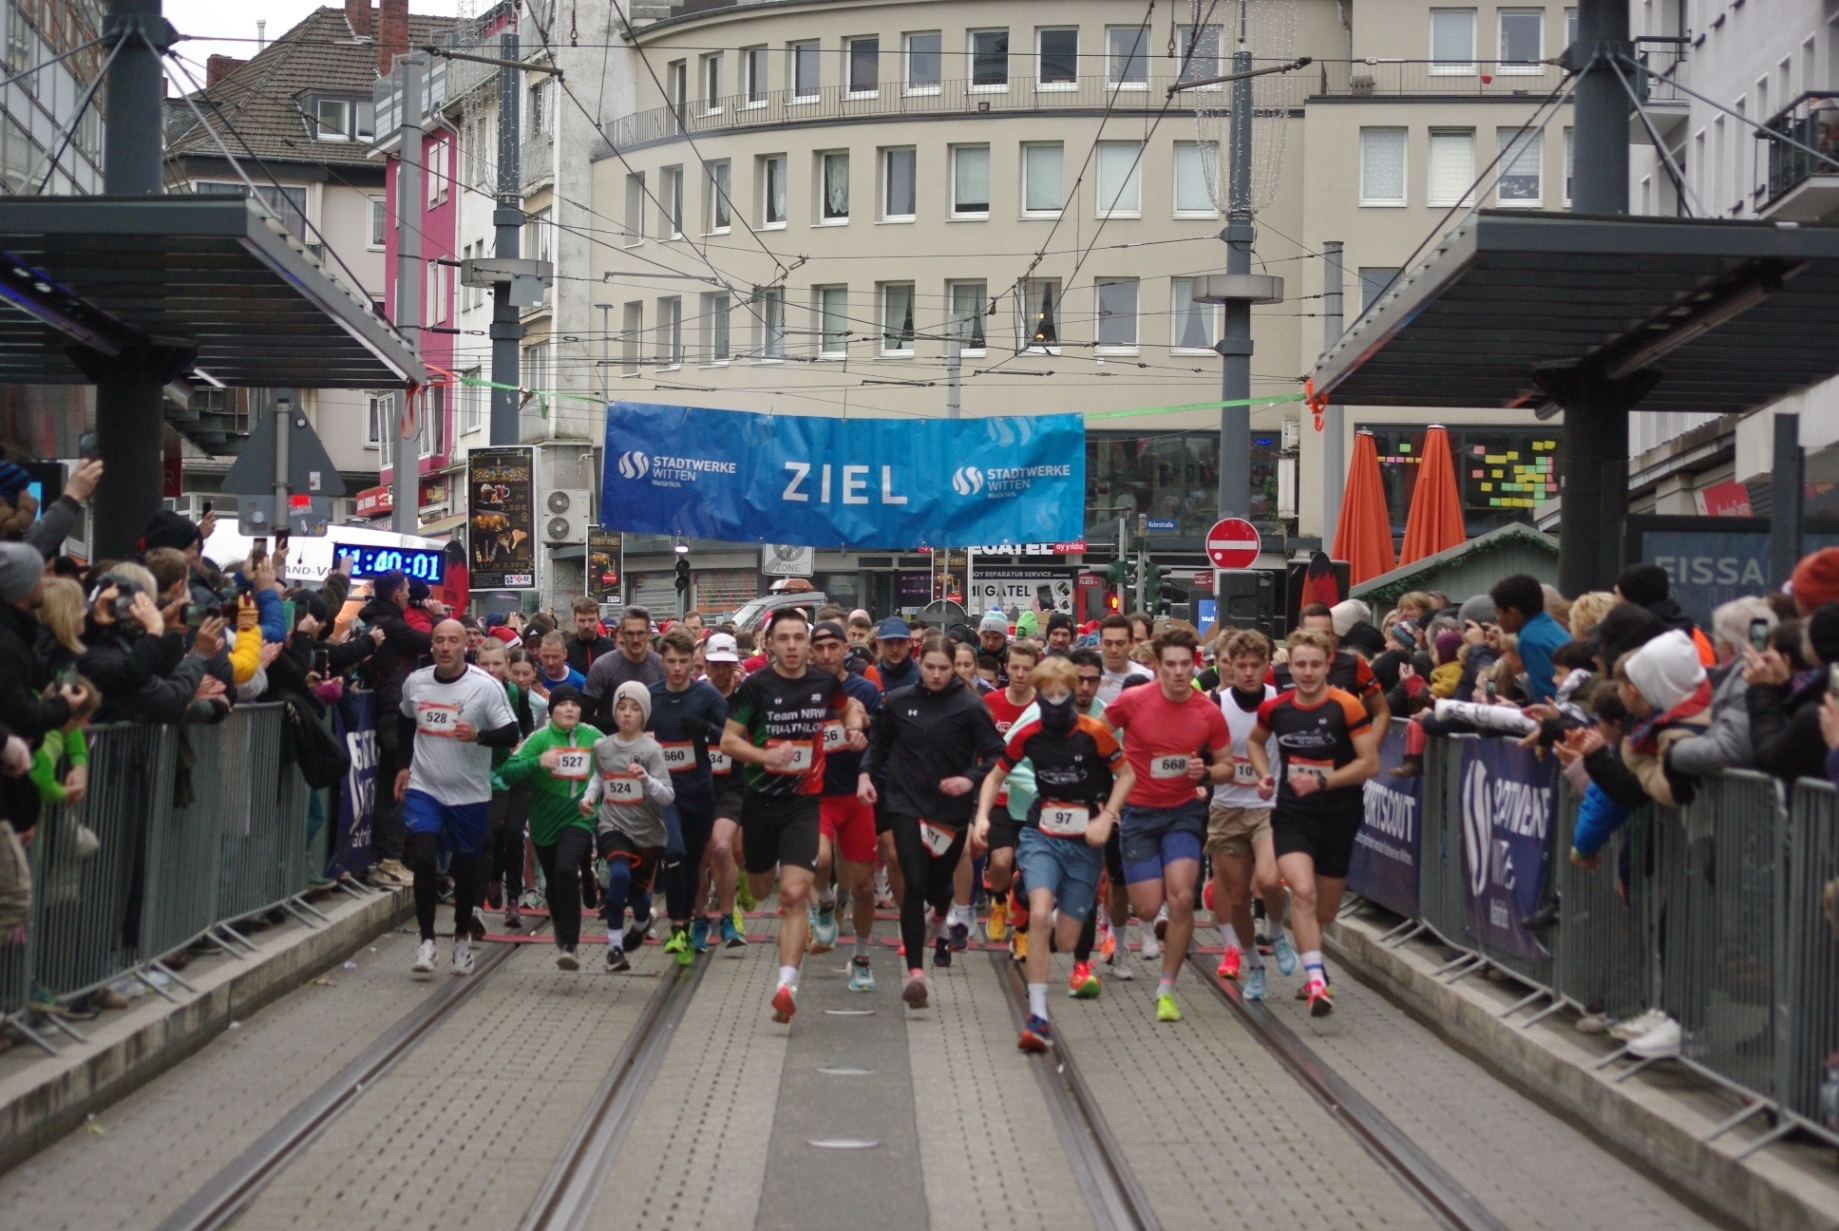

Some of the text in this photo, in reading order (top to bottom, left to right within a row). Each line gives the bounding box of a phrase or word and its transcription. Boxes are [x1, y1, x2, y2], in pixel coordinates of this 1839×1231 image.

[653, 456, 737, 474] STADTWERKE
[652, 468, 697, 482] WITTEN
[987, 464, 1071, 481] STADTWERKE
[782, 461, 908, 505] ZIEL
[987, 479, 1031, 492] WITTEN
[776, 563, 801, 572] ZONE
[1654, 556, 1772, 586] EISSA
[426, 711, 447, 724] 528
[766, 708, 826, 721] Team NRW
[765, 722, 823, 735] TRIATHLO
[562, 756, 583, 767] 527
[1162, 759, 1186, 770] 668
[610, 782, 631, 794] 524
[1055, 812, 1073, 824] 97
